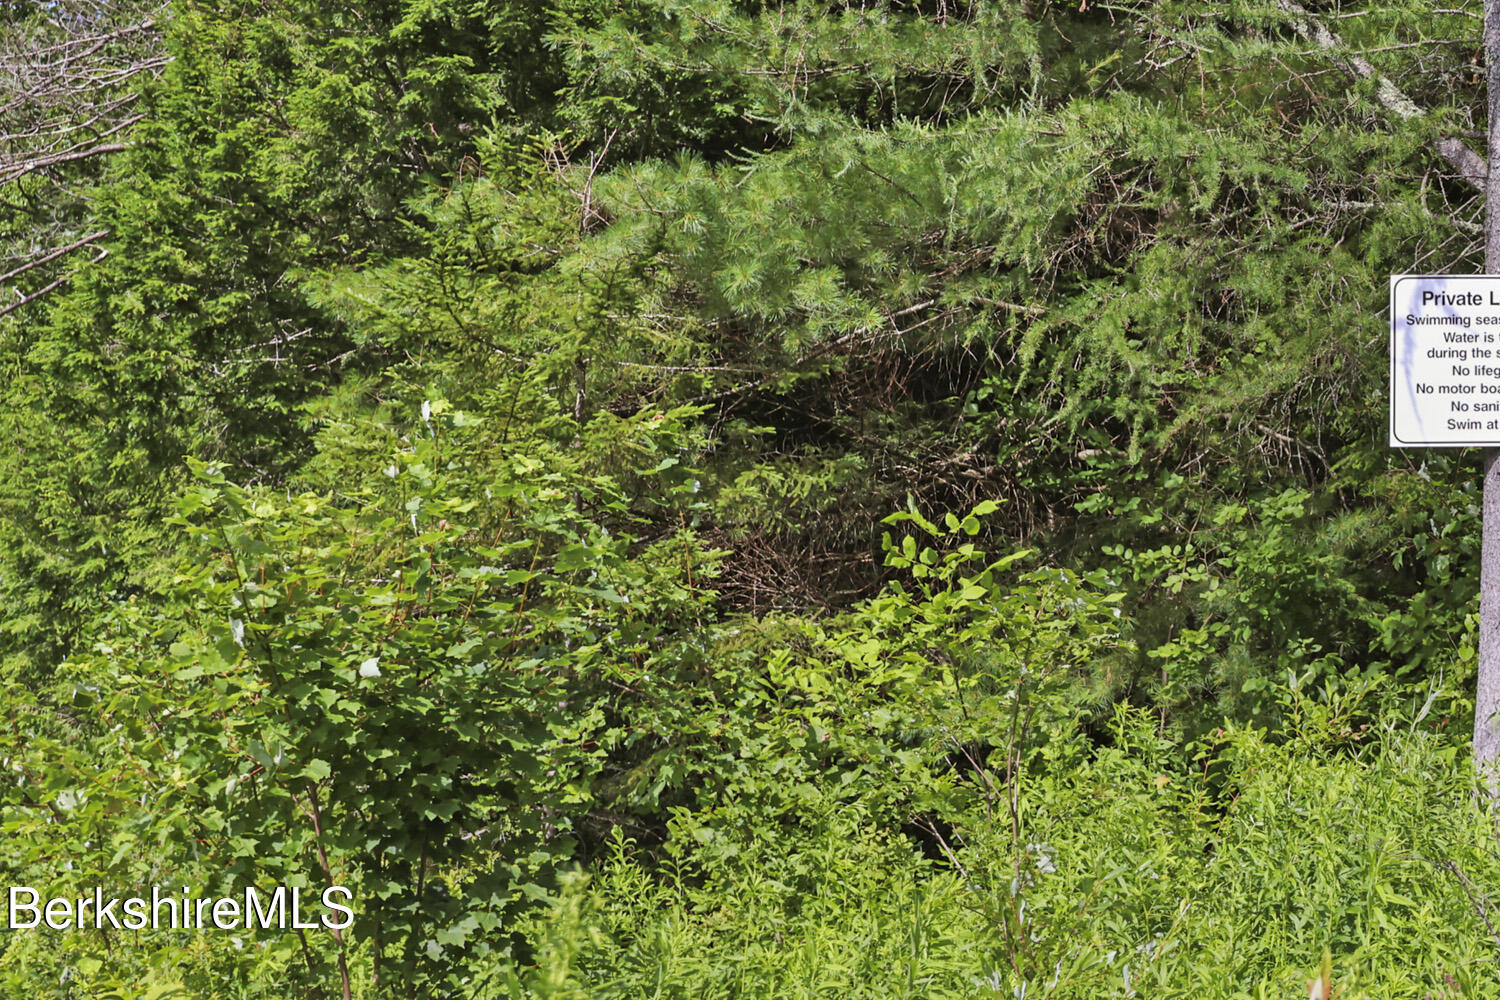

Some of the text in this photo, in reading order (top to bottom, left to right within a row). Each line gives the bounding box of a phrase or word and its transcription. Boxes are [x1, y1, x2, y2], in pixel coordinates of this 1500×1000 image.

[1422, 290, 1483, 307] Private
[1406, 313, 1471, 329] Swimming
[1443, 331, 1480, 343] Water
[1483, 331, 1495, 343] is
[1426, 347, 1467, 361] during
[1471, 346, 1492, 359] the
[1452, 364, 1470, 376] No
[1416, 382, 1434, 394] No
[1438, 383, 1476, 394] motor
[1450, 400, 1469, 412] No
[1447, 418, 1482, 430] Swim
[1486, 419, 1499, 430] at
